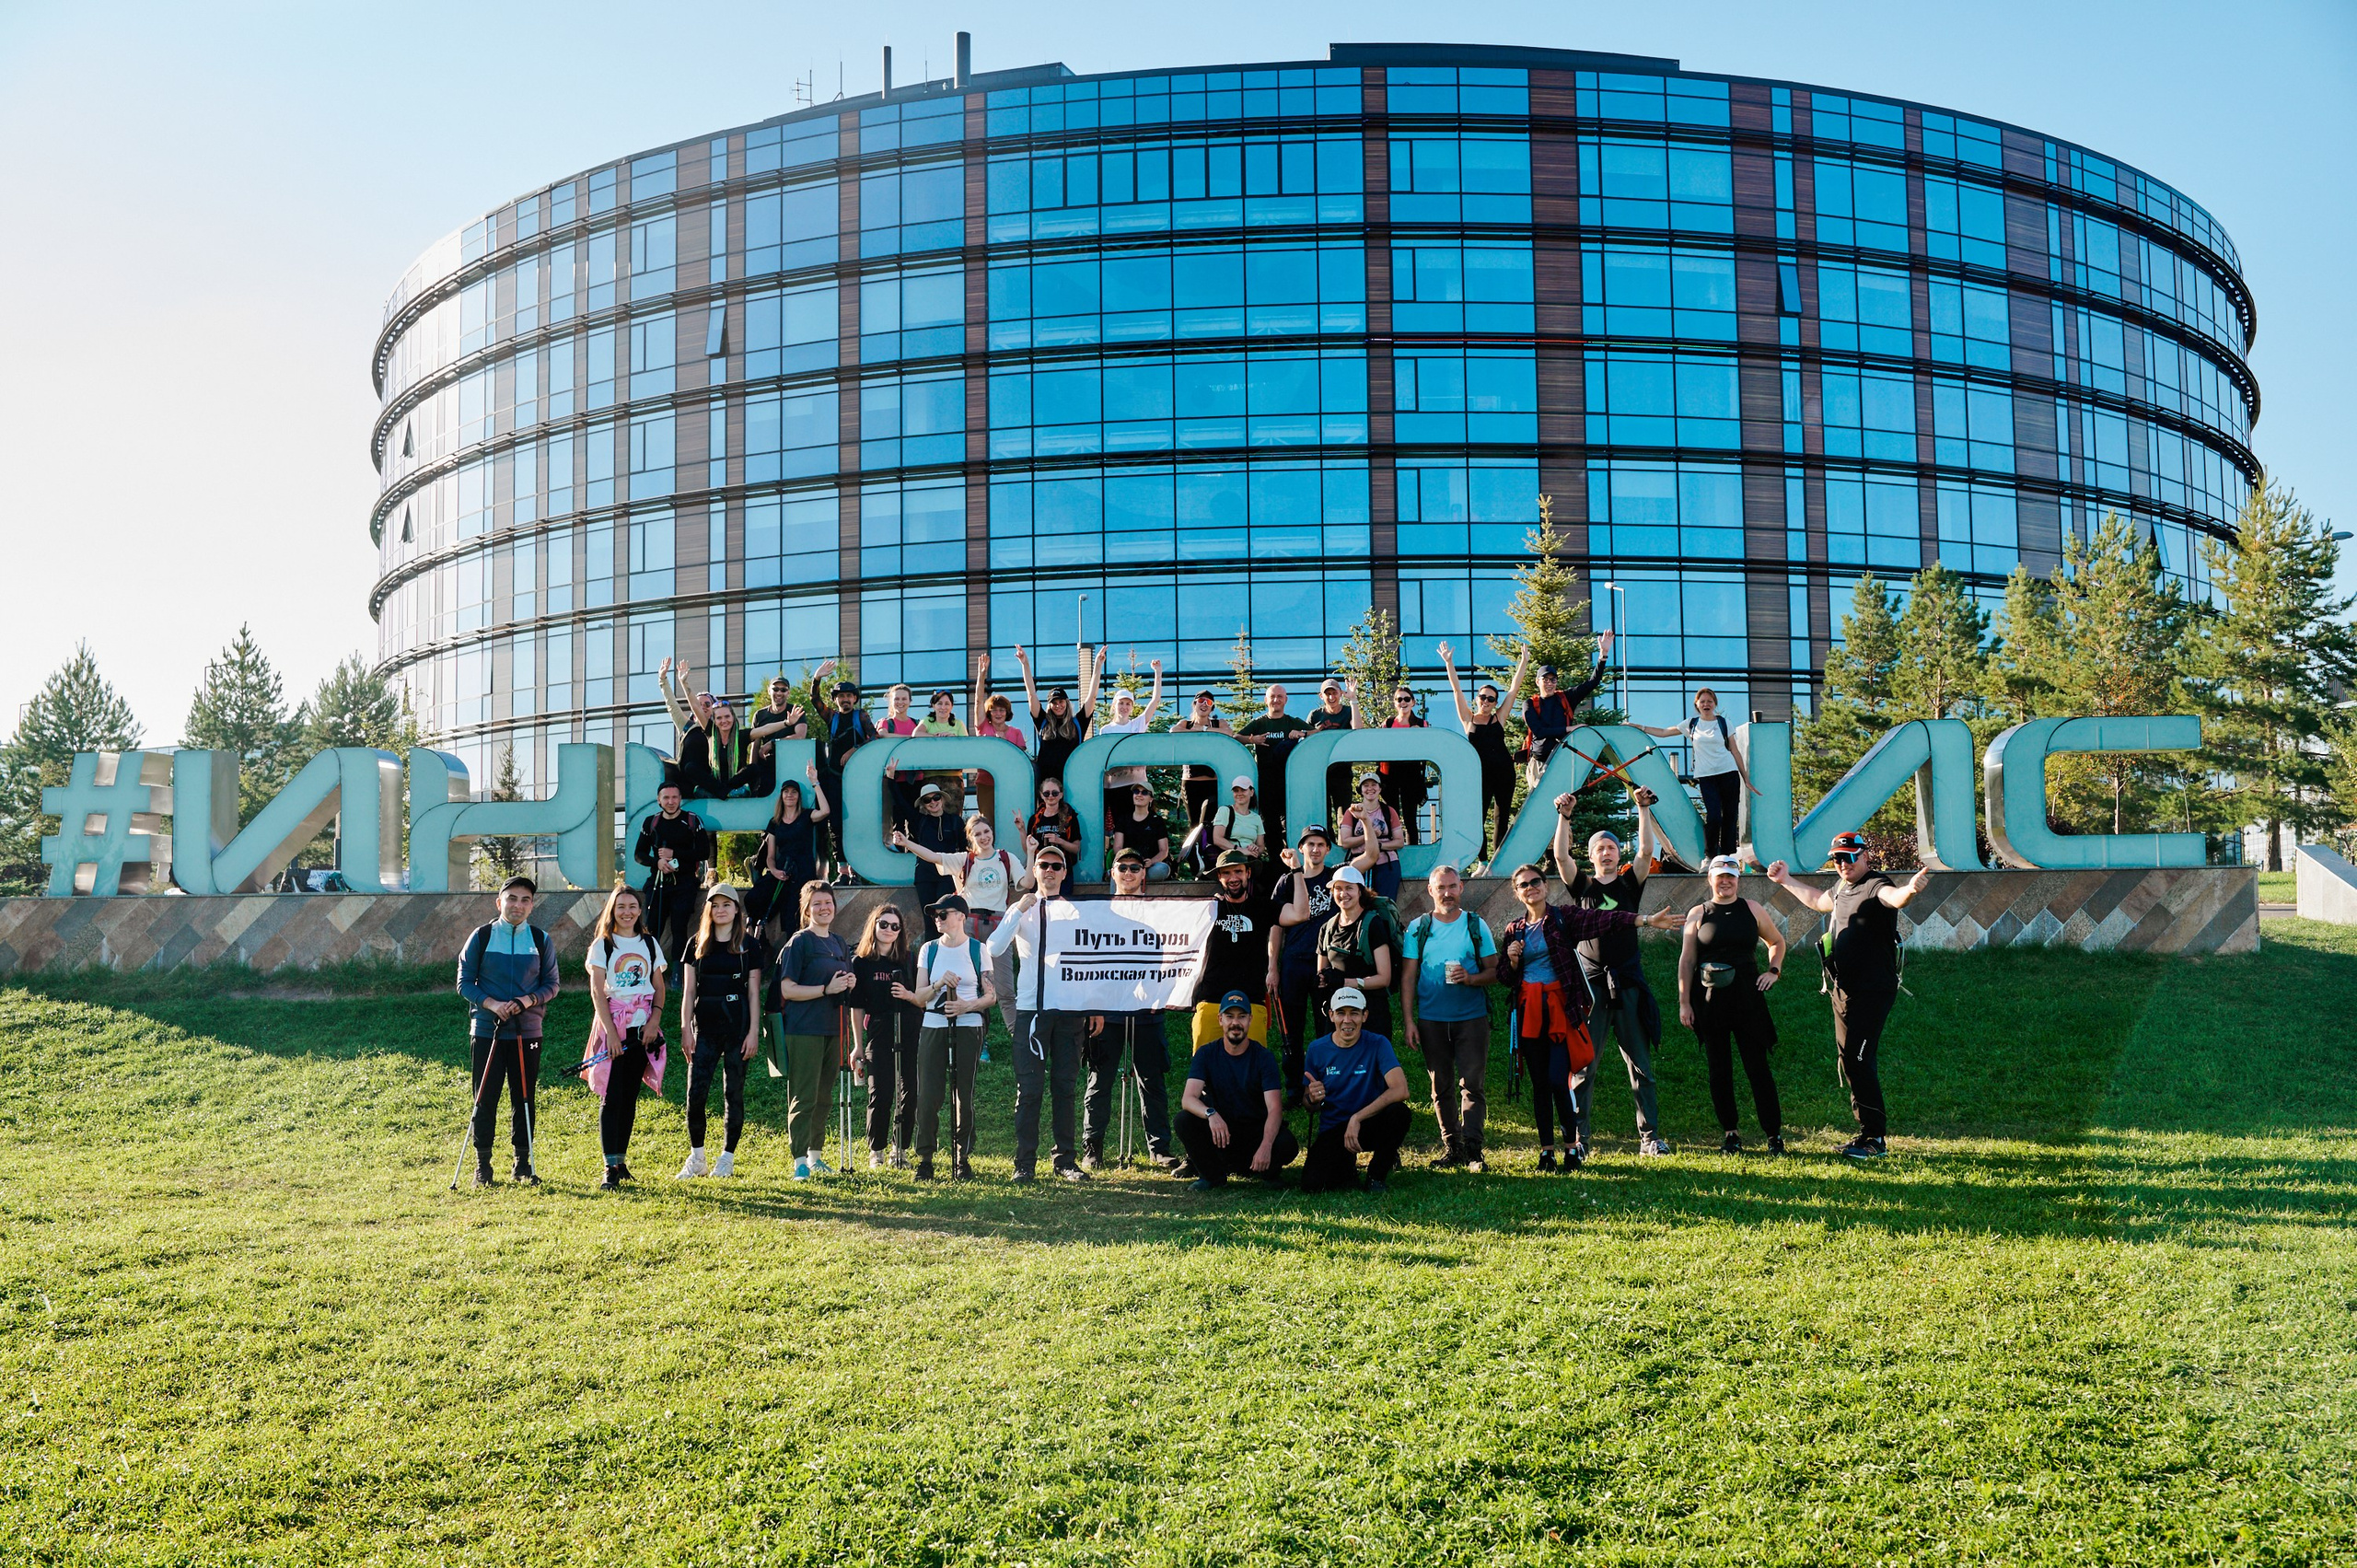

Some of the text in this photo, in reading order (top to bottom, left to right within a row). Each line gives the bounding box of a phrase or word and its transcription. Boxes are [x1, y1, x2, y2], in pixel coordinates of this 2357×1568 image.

[41, 715, 2207, 897] #ИННОПОЛИС
[1074, 929, 1189, 949] Путь Героя
[875, 972, 894, 981] TOK
[1062, 967, 1146, 982] Волжская
